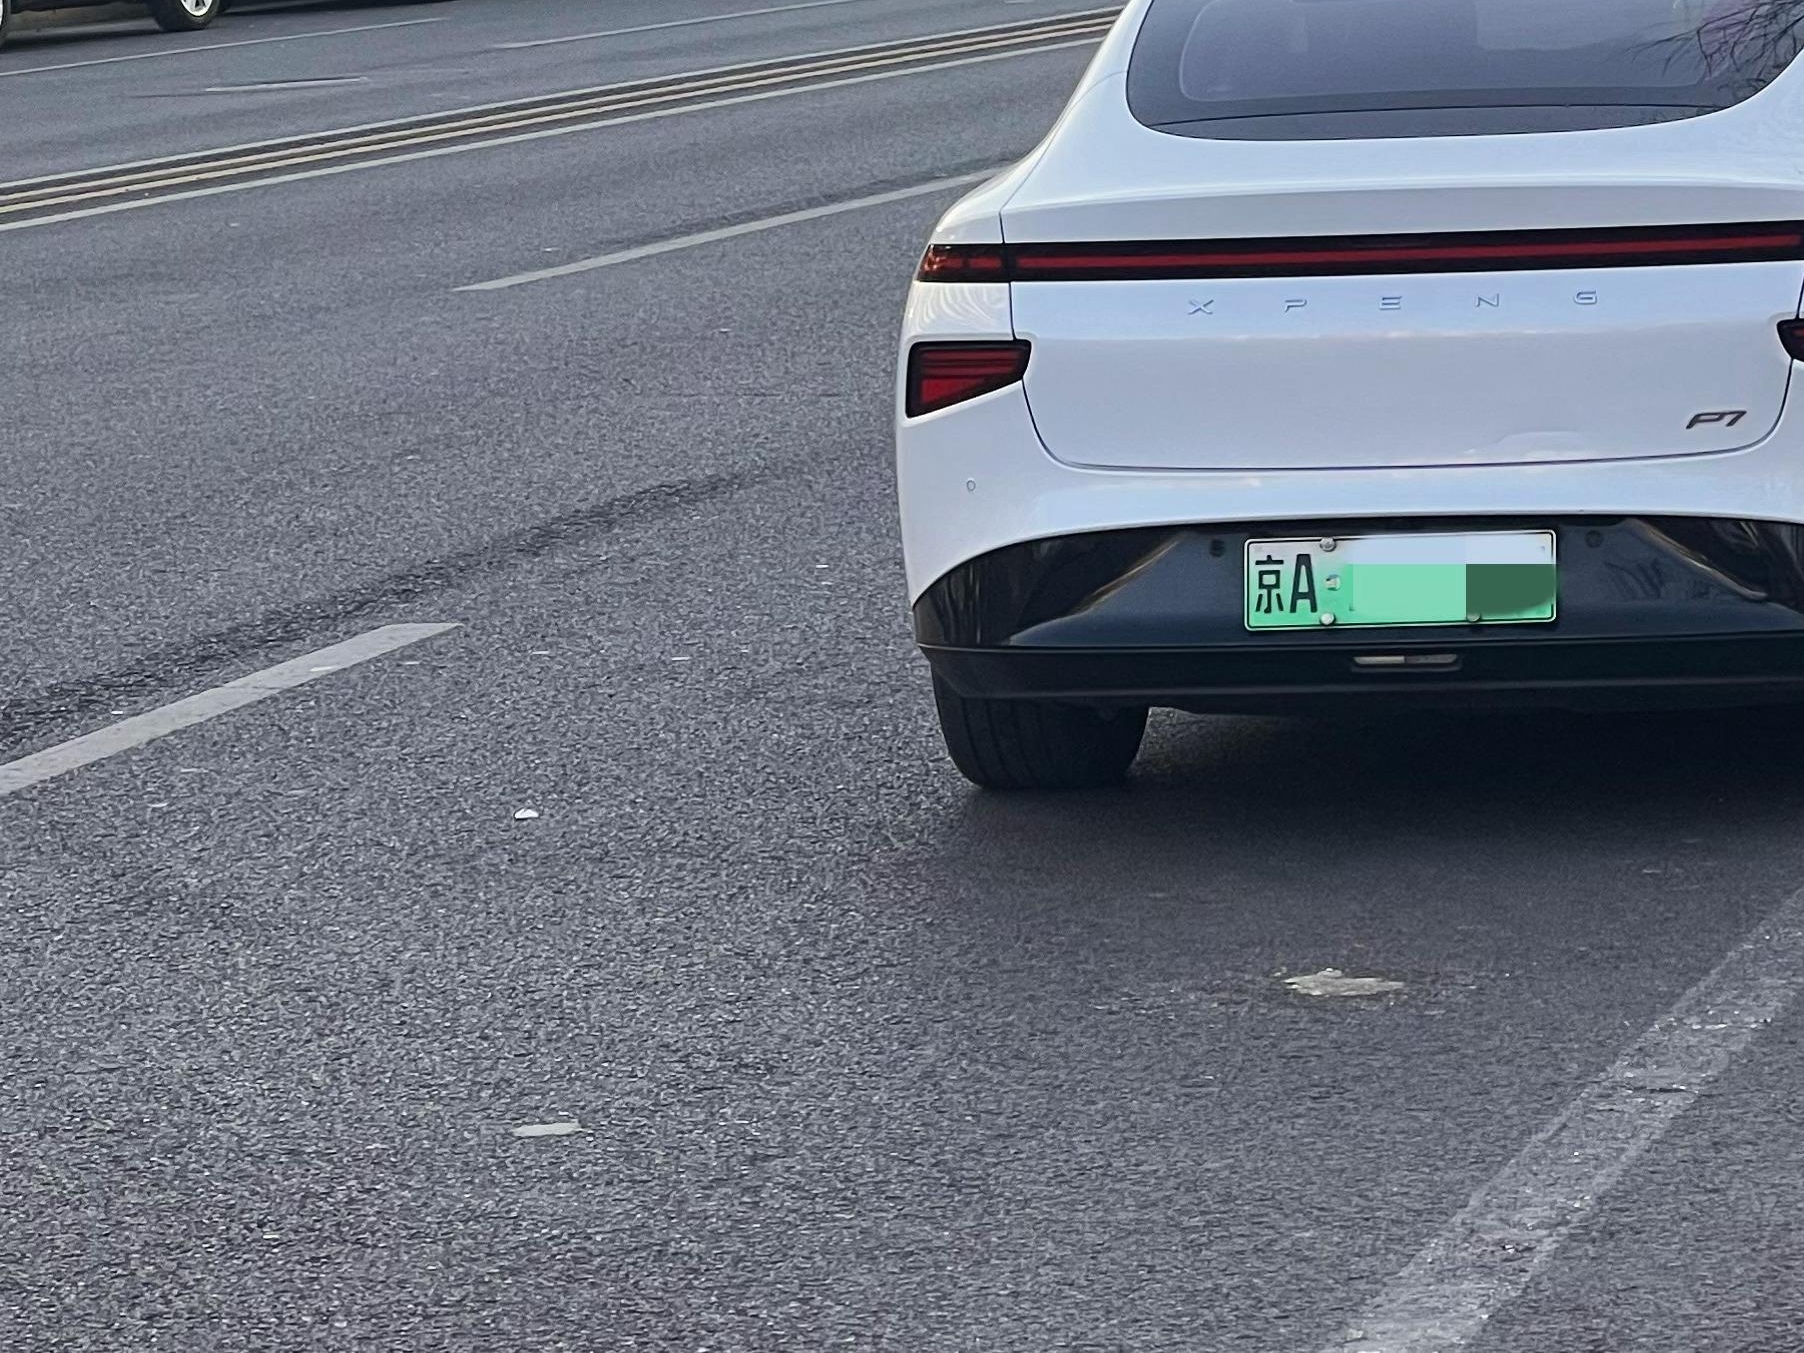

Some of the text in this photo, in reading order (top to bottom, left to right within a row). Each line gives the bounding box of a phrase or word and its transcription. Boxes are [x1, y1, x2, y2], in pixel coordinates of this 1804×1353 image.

[1187, 289, 1600, 316] XPENG
[1685, 409, 1748, 430] P7
[1254, 553, 1318, 614] 京A
